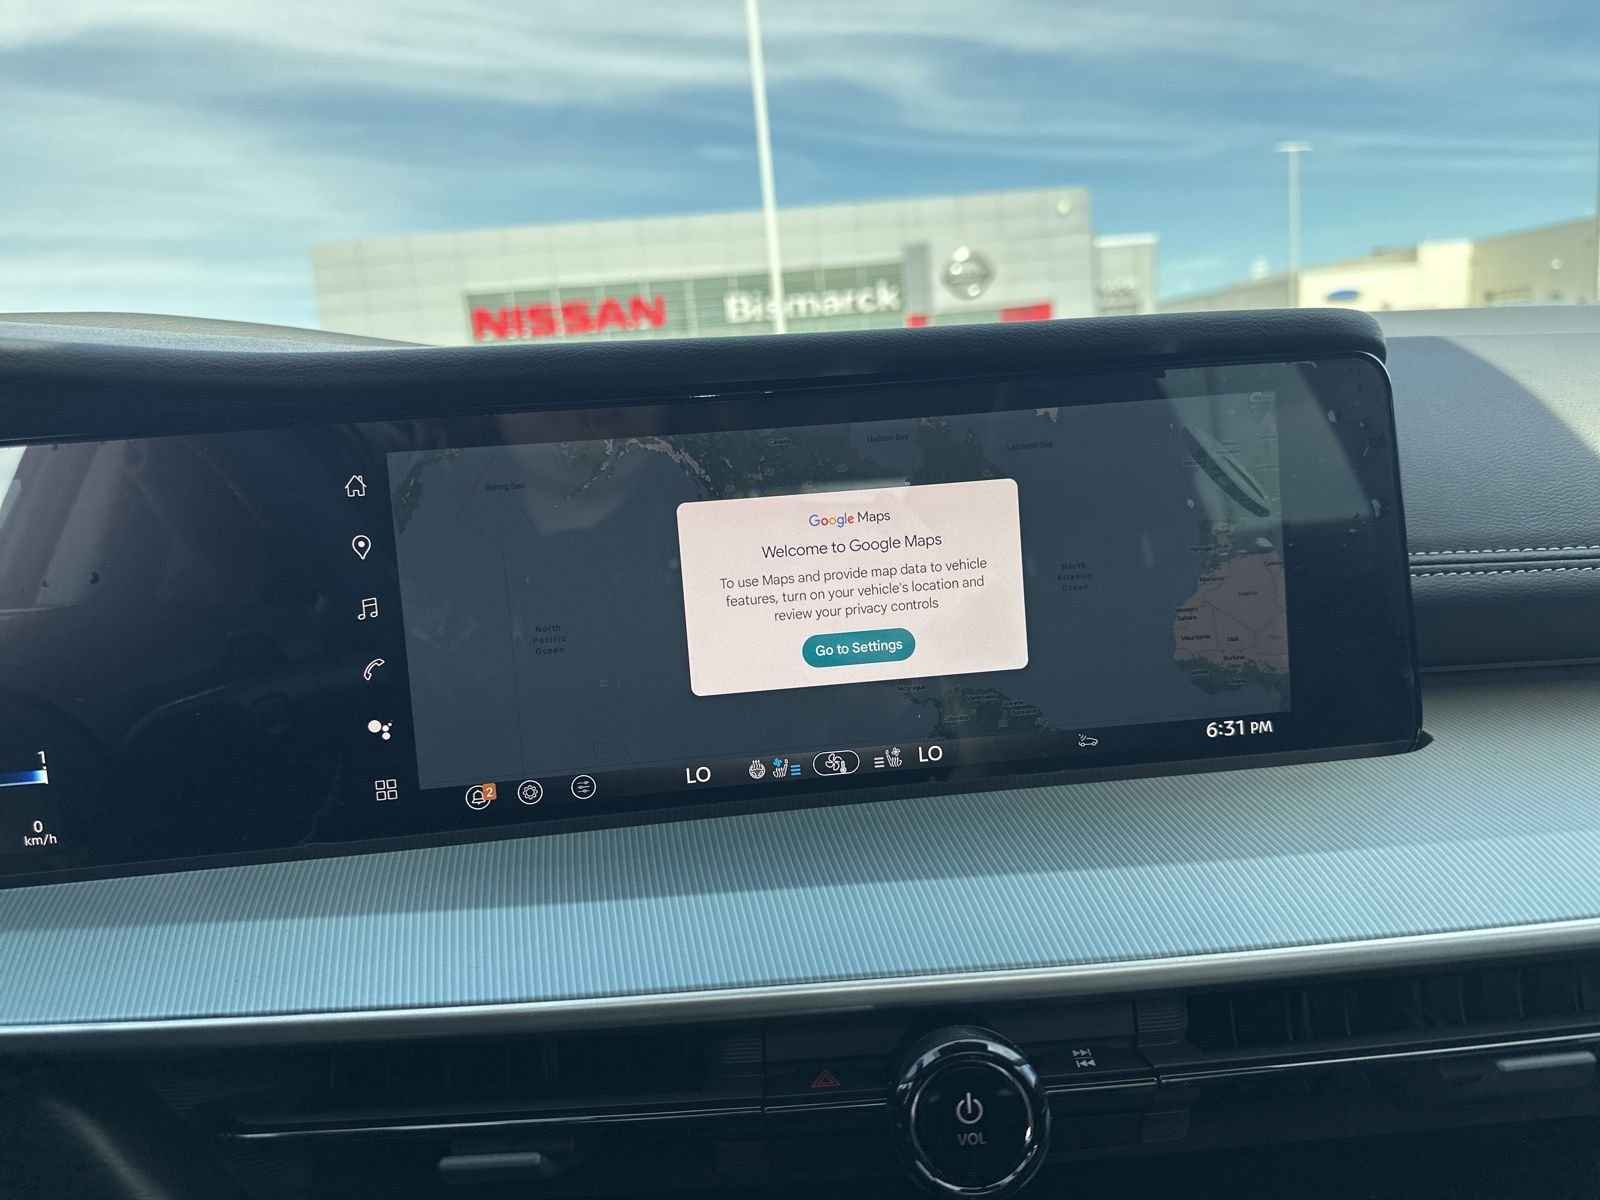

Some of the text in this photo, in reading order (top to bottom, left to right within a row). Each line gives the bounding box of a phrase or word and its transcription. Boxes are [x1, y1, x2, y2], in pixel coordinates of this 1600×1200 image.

[472, 279, 901, 342] NISSAN Bismarck
[809, 510, 891, 528] Google Maps
[761, 533, 943, 559] Welcome to Google Maps
[720, 557, 988, 590] To use Maps and provide map data to vehicle
[725, 574, 985, 607] features, turn on your vehicle's location and
[774, 596, 939, 622] review your privacy controls
[535, 624, 561, 633] North
[815, 638, 903, 657] Go to Settings
[1206, 719, 1273, 738] 6:31 PM
[918, 744, 944, 764] LO
[686, 766, 711, 785] LO
[486, 785, 494, 798] 2
[33, 820, 43, 833] 0
[24, 833, 58, 847] km/h
[957, 1132, 987, 1146] VOL
